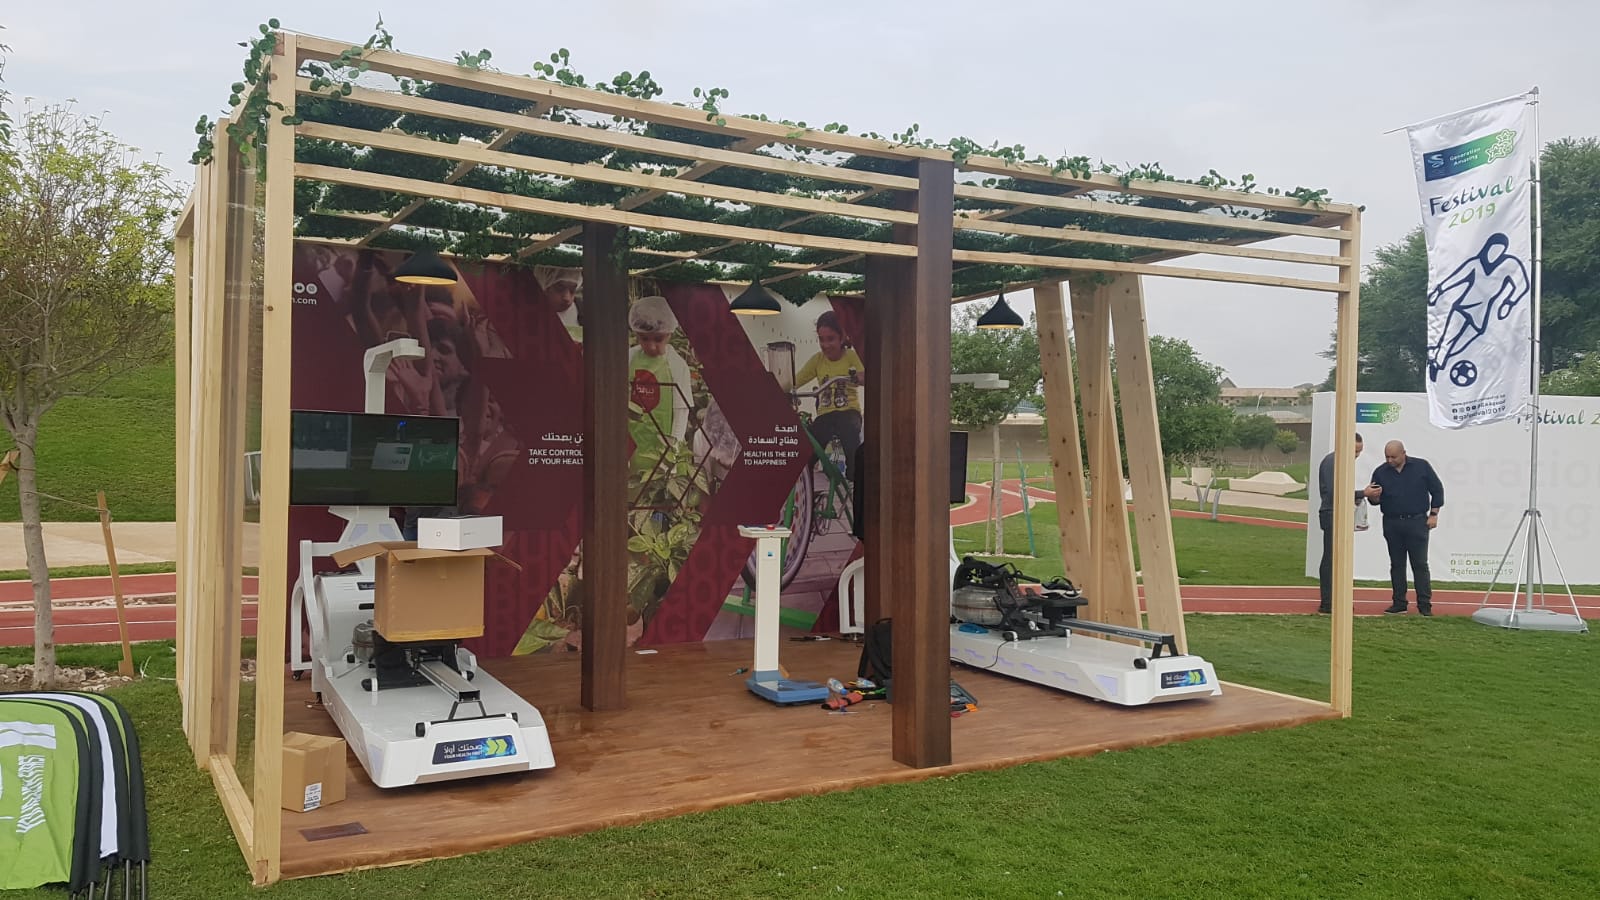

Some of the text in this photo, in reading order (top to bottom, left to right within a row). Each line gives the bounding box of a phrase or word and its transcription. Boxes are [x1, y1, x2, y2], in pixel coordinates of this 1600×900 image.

[1429, 176, 1514, 216] Festival
[1448, 202, 1496, 228] 2019
[549, 449, 584, 457] CONTROL
